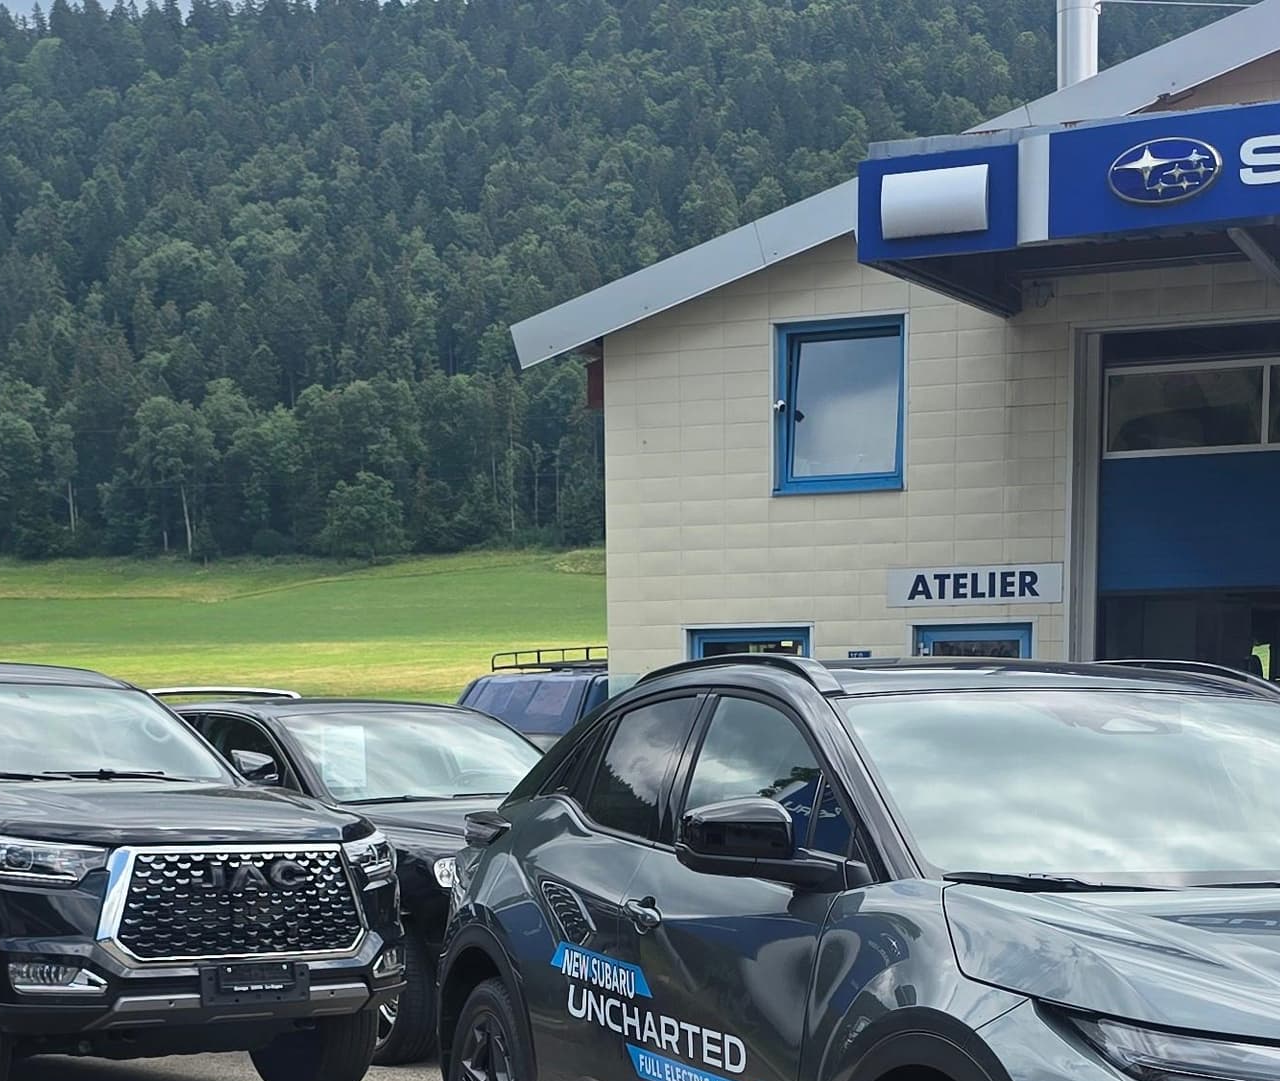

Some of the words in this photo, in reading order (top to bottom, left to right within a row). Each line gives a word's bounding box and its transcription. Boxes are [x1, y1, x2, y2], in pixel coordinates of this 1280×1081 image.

[907, 570, 1040, 601] ATELIER
[202, 859, 307, 891] JAC
[561, 949, 589, 979] NEW
[591, 957, 635, 999] SUBARU
[567, 984, 747, 1074] UNCHARTED
[639, 1054, 663, 1079] FULL
